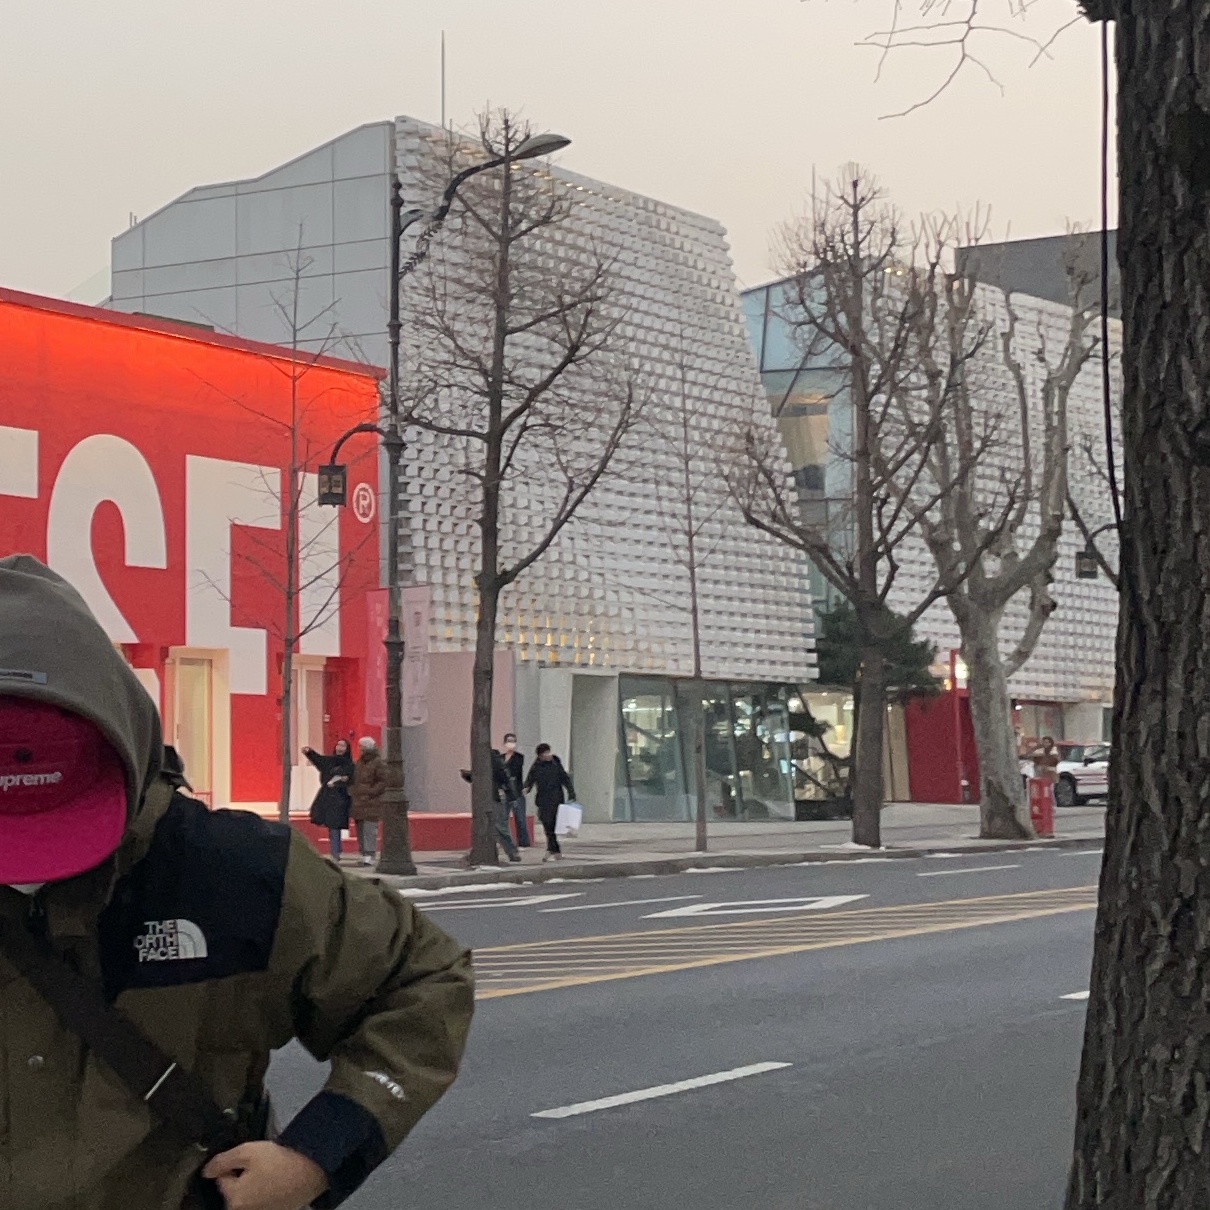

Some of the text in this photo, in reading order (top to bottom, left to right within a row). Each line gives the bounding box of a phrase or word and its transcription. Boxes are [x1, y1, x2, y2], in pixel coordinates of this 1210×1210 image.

[144, 919, 177, 935] THE
[133, 933, 179, 950] ORTH
[139, 947, 179, 962] FACE
